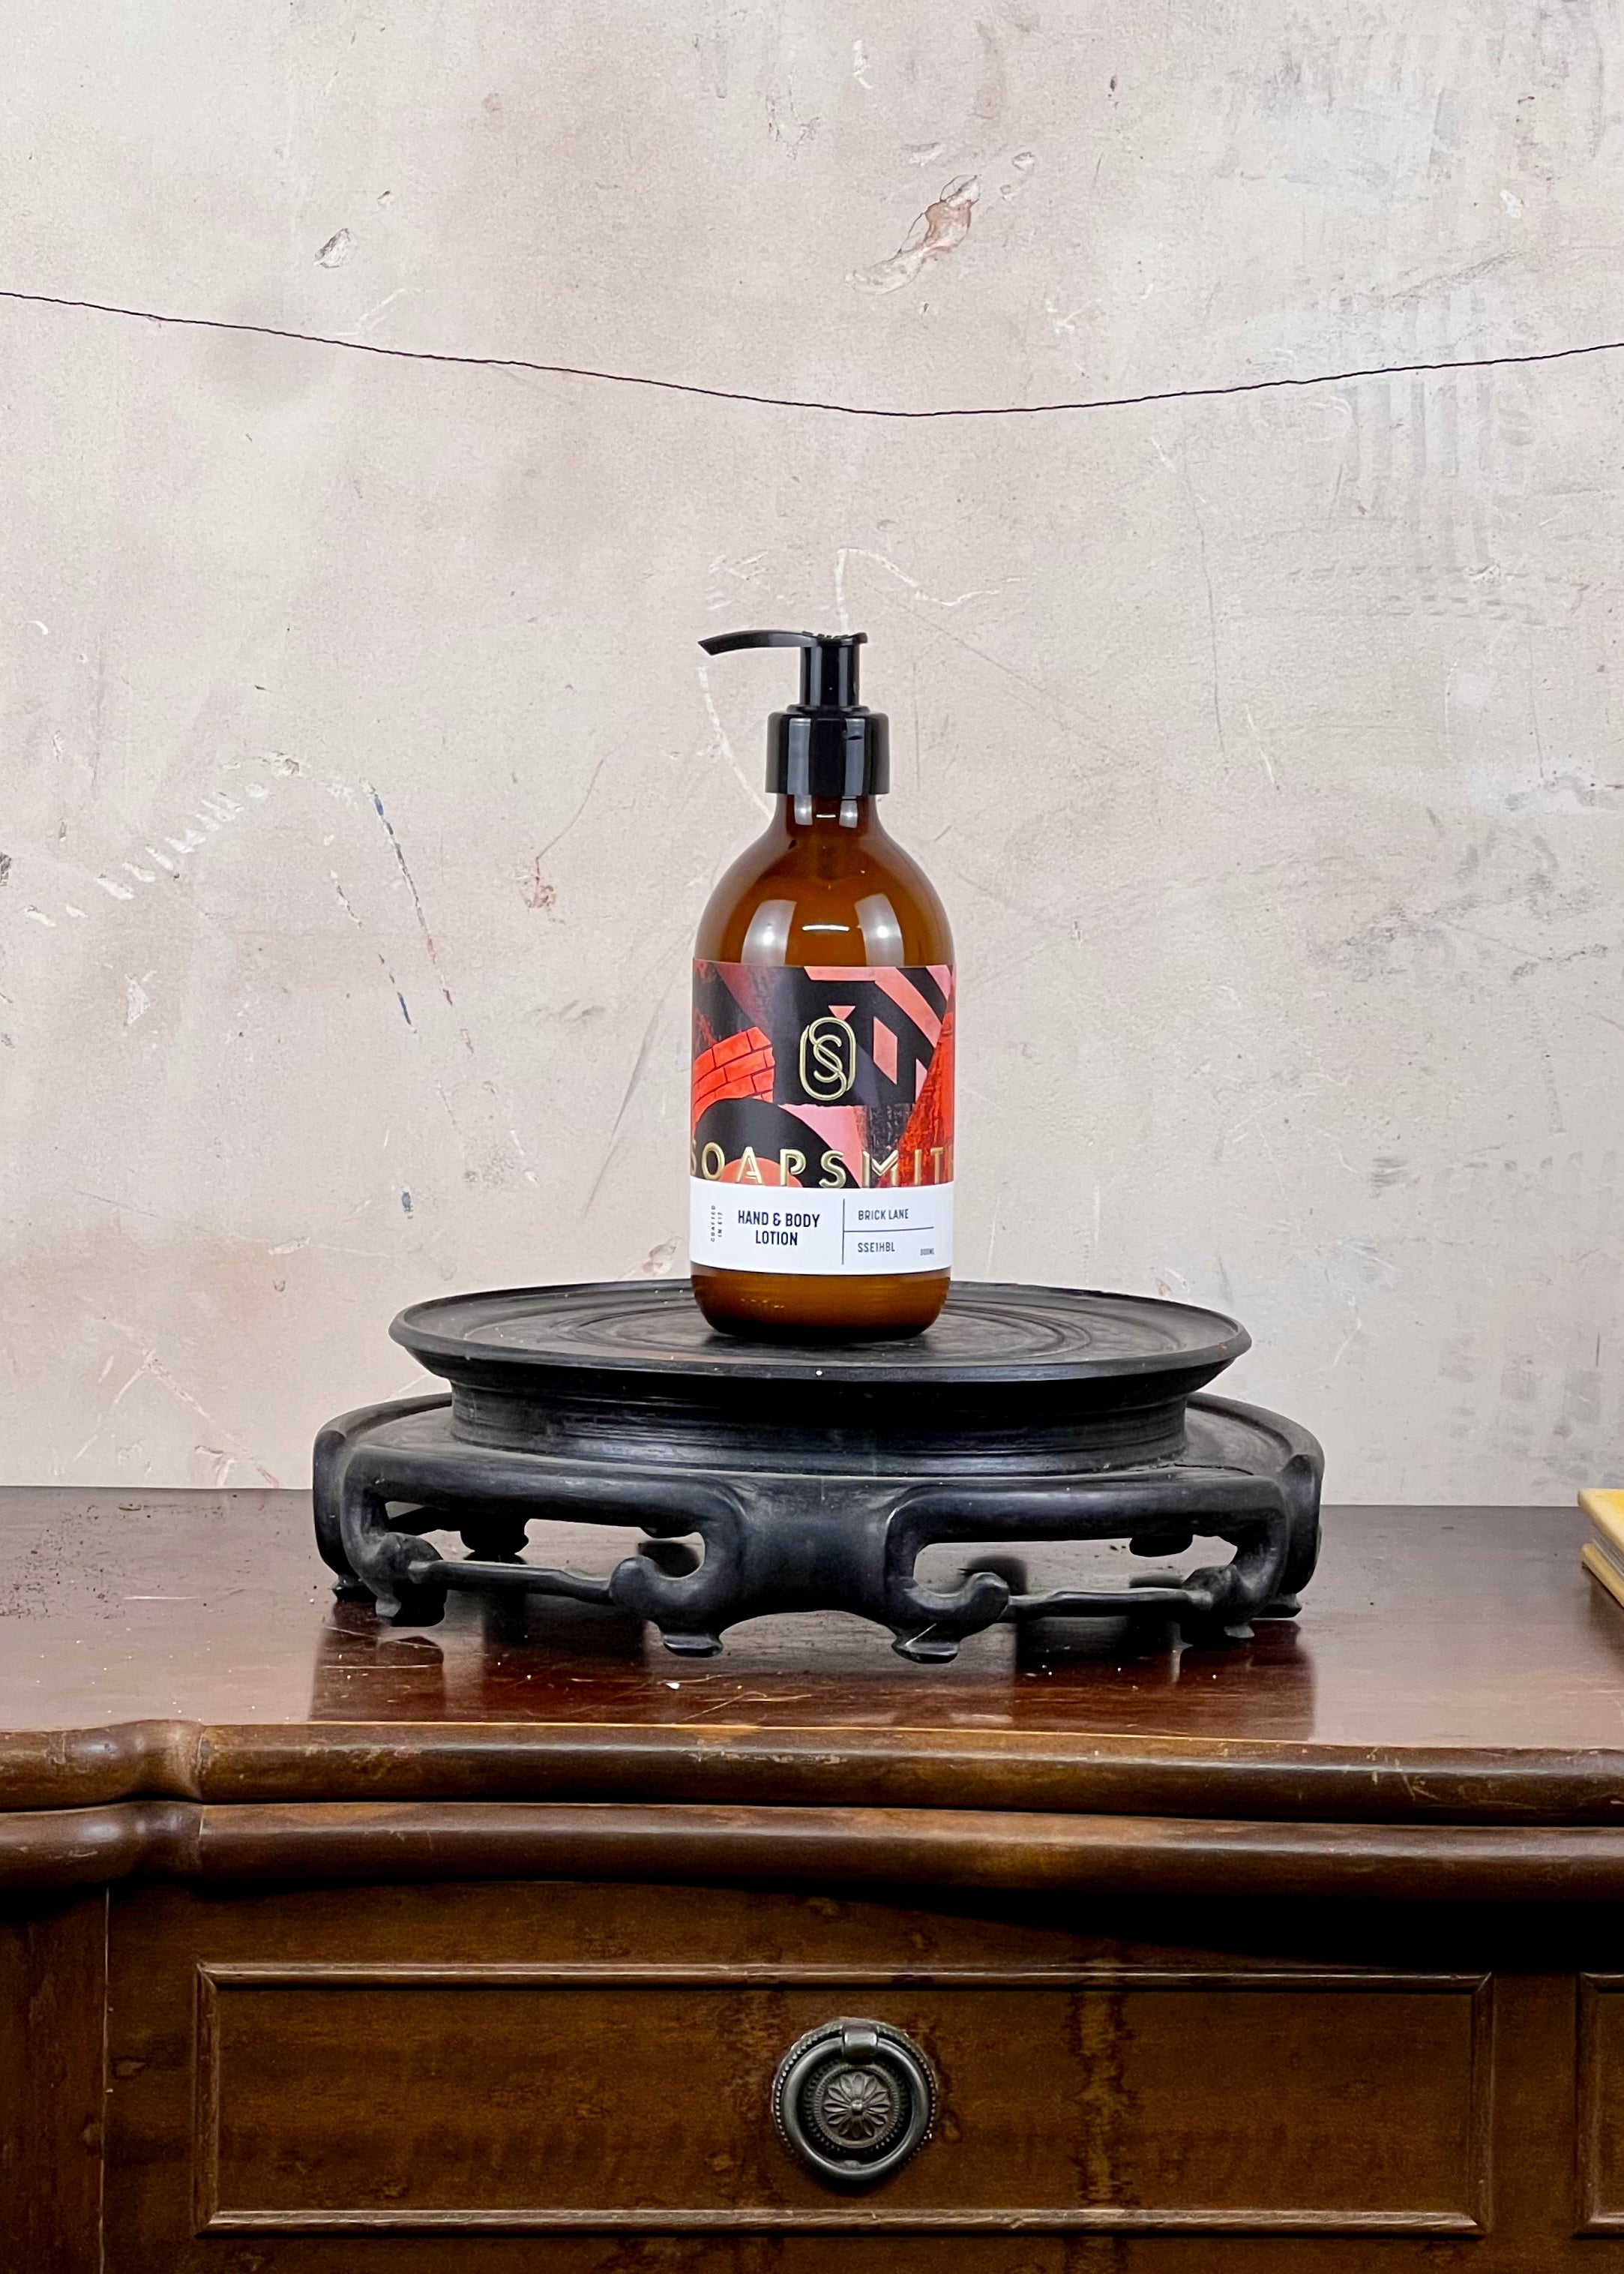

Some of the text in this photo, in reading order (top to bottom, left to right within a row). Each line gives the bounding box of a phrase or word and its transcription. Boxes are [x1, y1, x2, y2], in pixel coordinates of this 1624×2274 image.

[738, 1210, 820, 1228] HAND & BODY
[858, 1208, 909, 1220] BRICK LANE
[755, 1230, 799, 1246] LOTION
